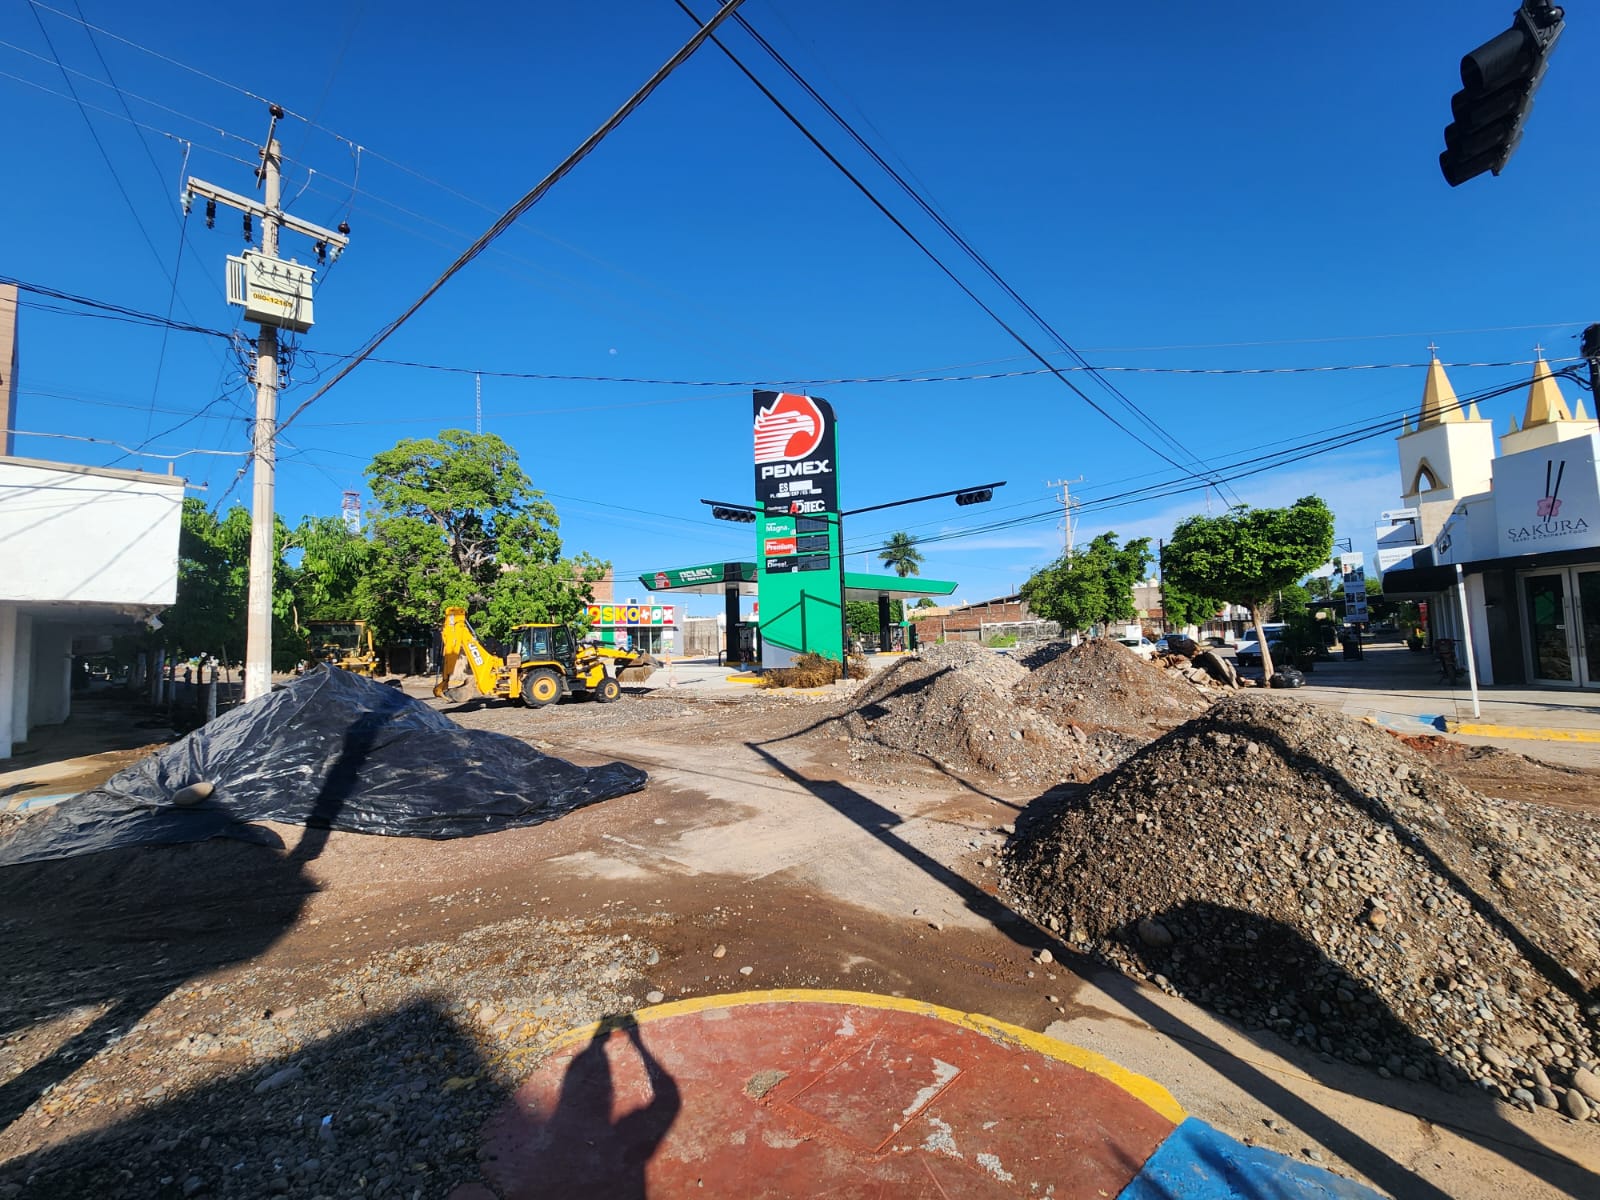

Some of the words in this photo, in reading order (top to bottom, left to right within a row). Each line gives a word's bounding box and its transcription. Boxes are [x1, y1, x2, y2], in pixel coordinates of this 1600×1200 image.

[761, 459, 829, 480] PEMEX
[1508, 517, 1589, 539] SAKURA
[468, 642, 484, 666] JCB
